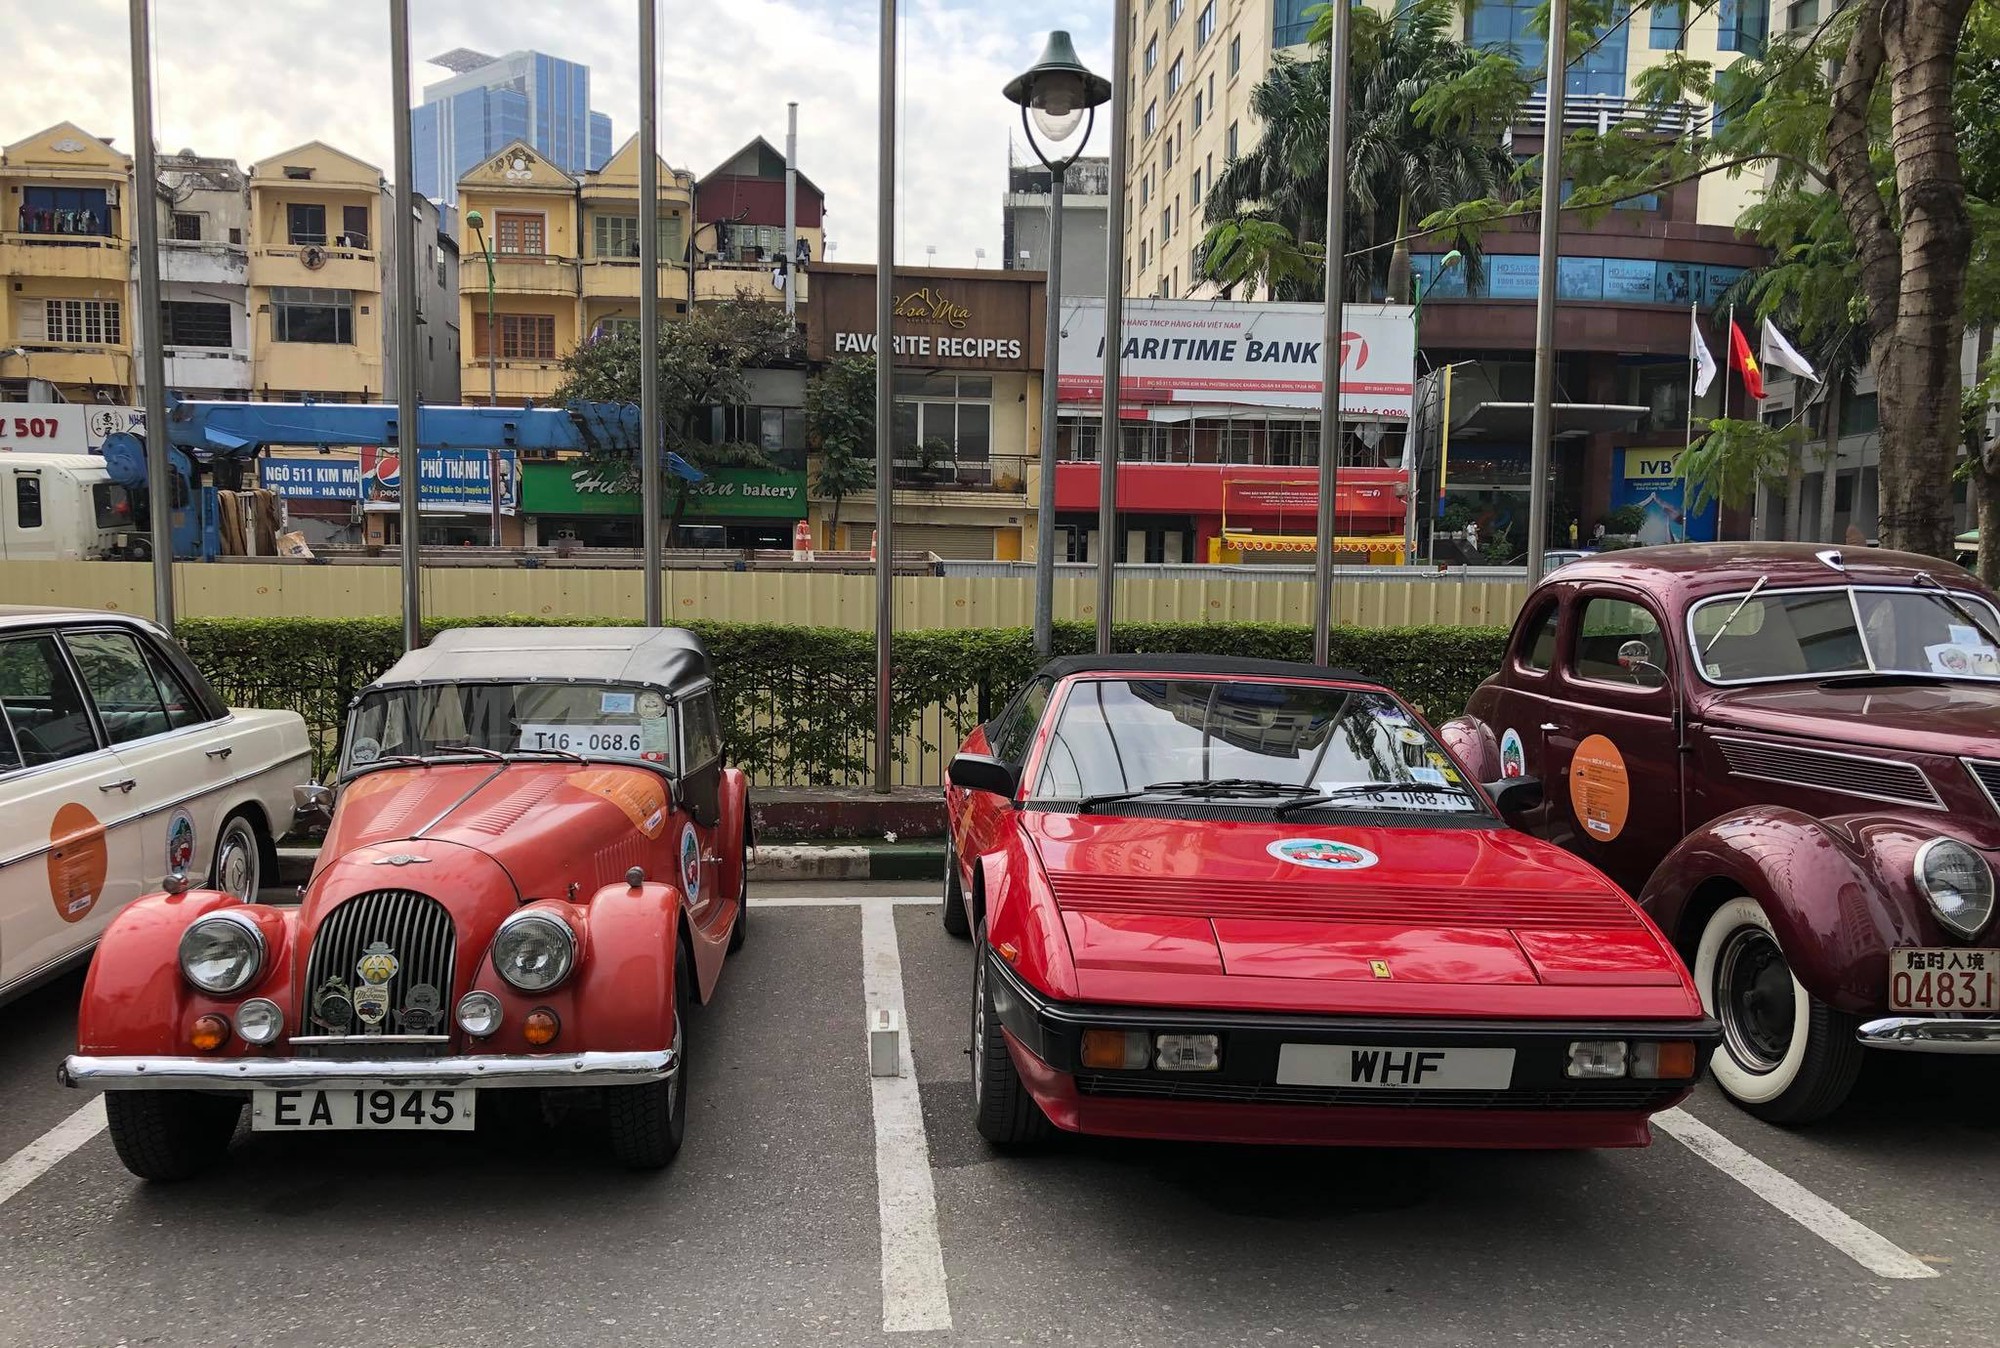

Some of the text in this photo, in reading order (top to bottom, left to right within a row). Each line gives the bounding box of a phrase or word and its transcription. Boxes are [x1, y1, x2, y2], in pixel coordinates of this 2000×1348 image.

[1149, 319, 1170, 328] TMCP
[1223, 321, 1242, 329] NAM
[937, 337, 1022, 360] RECIPES
[1245, 340, 1321, 364] BANK
[14, 417, 59, 438] 507
[265, 465, 290, 481] NGÕ
[292, 467, 313, 482] 511
[316, 468, 339, 483] KIM
[420, 451, 443, 478] PHỞ
[445, 455, 480, 480] THÀNH
[288, 485, 313, 495] ĐÌNH
[322, 486, 336, 496] HÀ
[338, 486, 357, 498] NỘI
[742, 483, 798, 499] bakery
[534, 732, 570, 751] T16
[589, 733, 641, 751] 068.6
[1906, 952, 1985, 970] 临时入境
[1351, 1050, 1446, 1084] WHF
[274, 1090, 455, 1126] EA 1945
